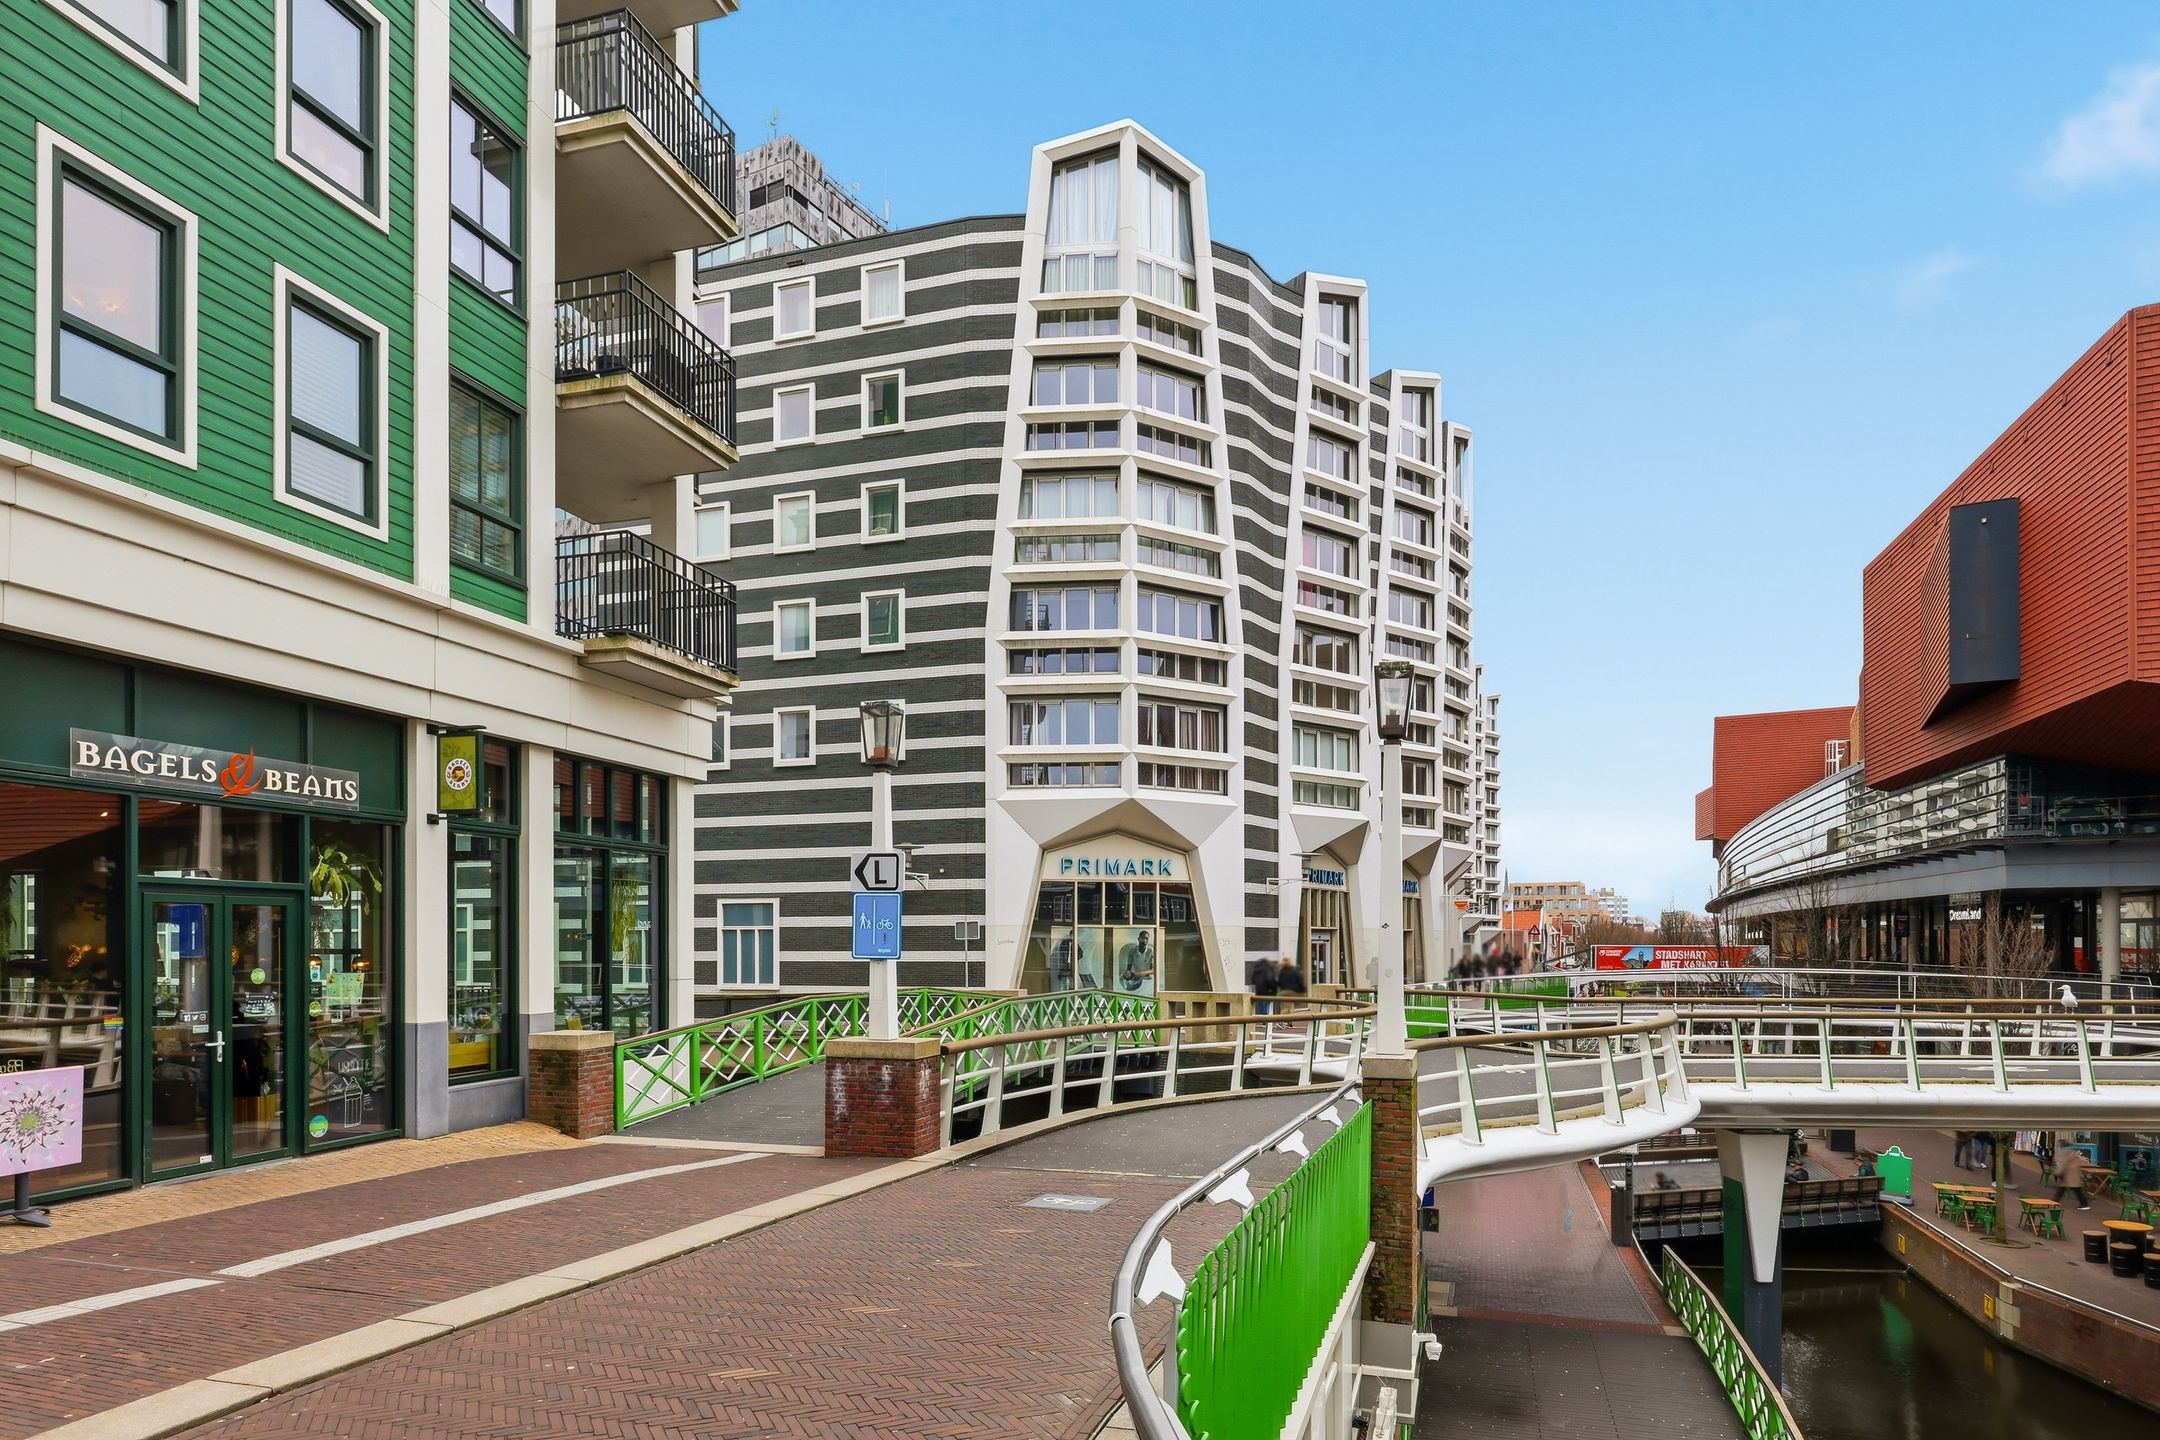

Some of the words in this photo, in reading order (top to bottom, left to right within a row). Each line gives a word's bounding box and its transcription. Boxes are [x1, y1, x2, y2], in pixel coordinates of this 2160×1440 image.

[76, 740, 217, 783] BAGELS
[220, 747, 263, 799] &
[264, 768, 358, 801] BEANS
[874, 860, 887, 885] L
[1060, 857, 1172, 876] PRIMARK
